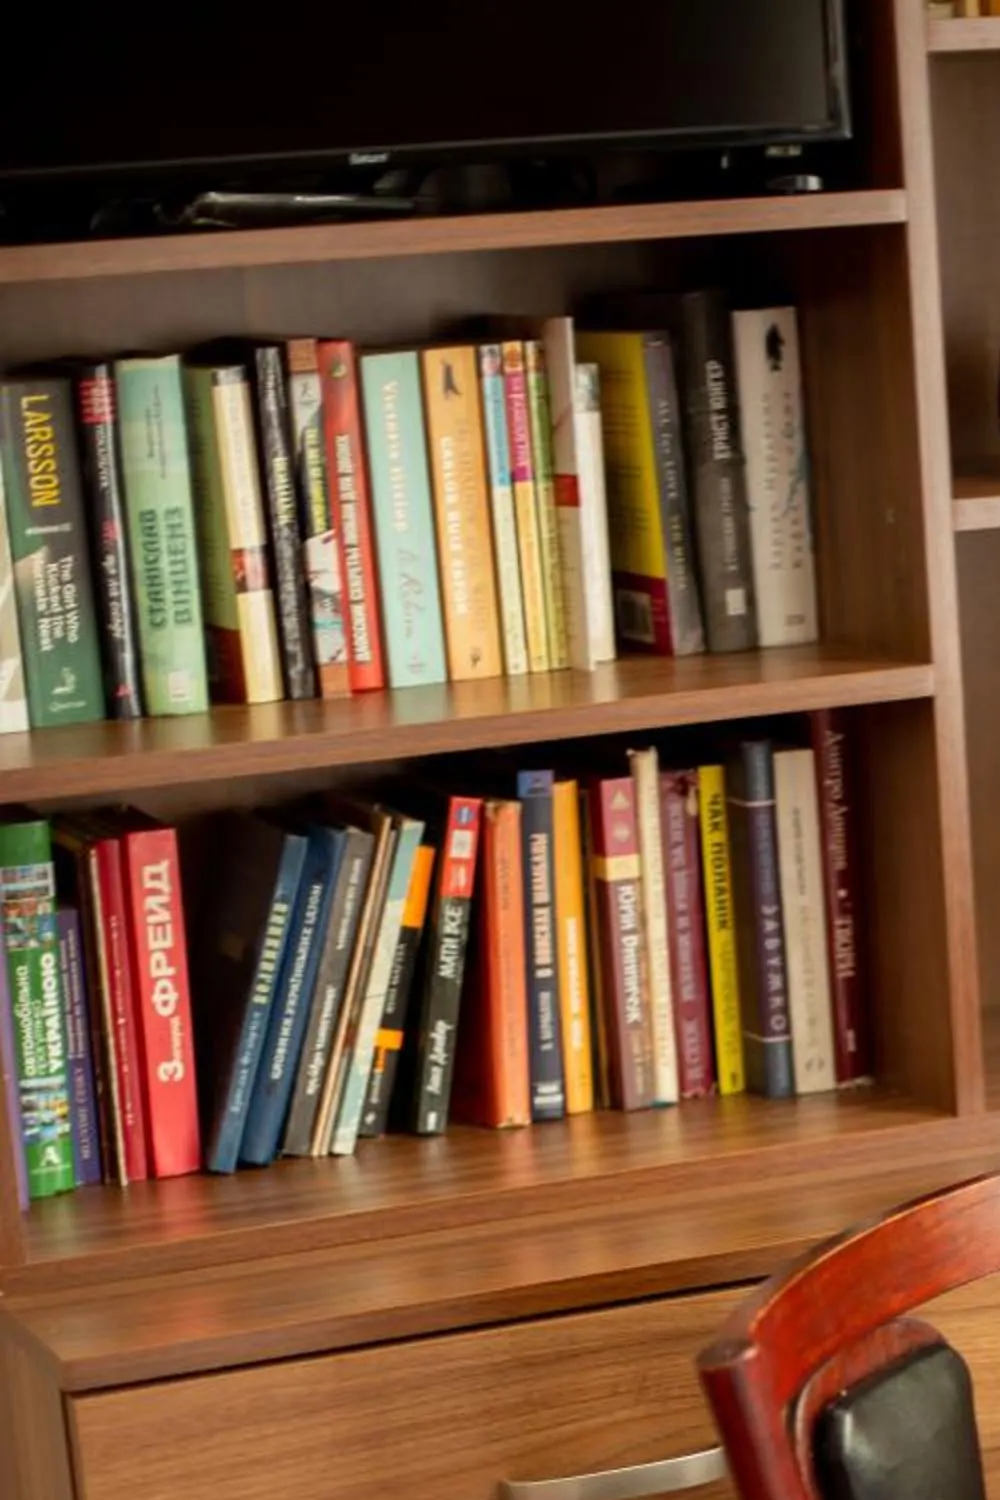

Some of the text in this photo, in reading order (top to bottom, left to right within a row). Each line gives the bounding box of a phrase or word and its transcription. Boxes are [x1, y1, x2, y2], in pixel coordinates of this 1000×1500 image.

[20, 393, 60, 508] LARSSON
[380, 380, 404, 460] Victoria
[437, 435, 460, 503] CARLOS
[661, 459, 680, 500] LOVE
[445, 510, 464, 552] RUIZ
[42, 562, 65, 613] Kicked
[58, 554, 83, 644] The Girl Who
[35, 616, 55, 651] Nest
[761, 903, 787, 1032] ЗАБУЖКО
[37, 950, 64, 1073] УКРАЇНОЮ
